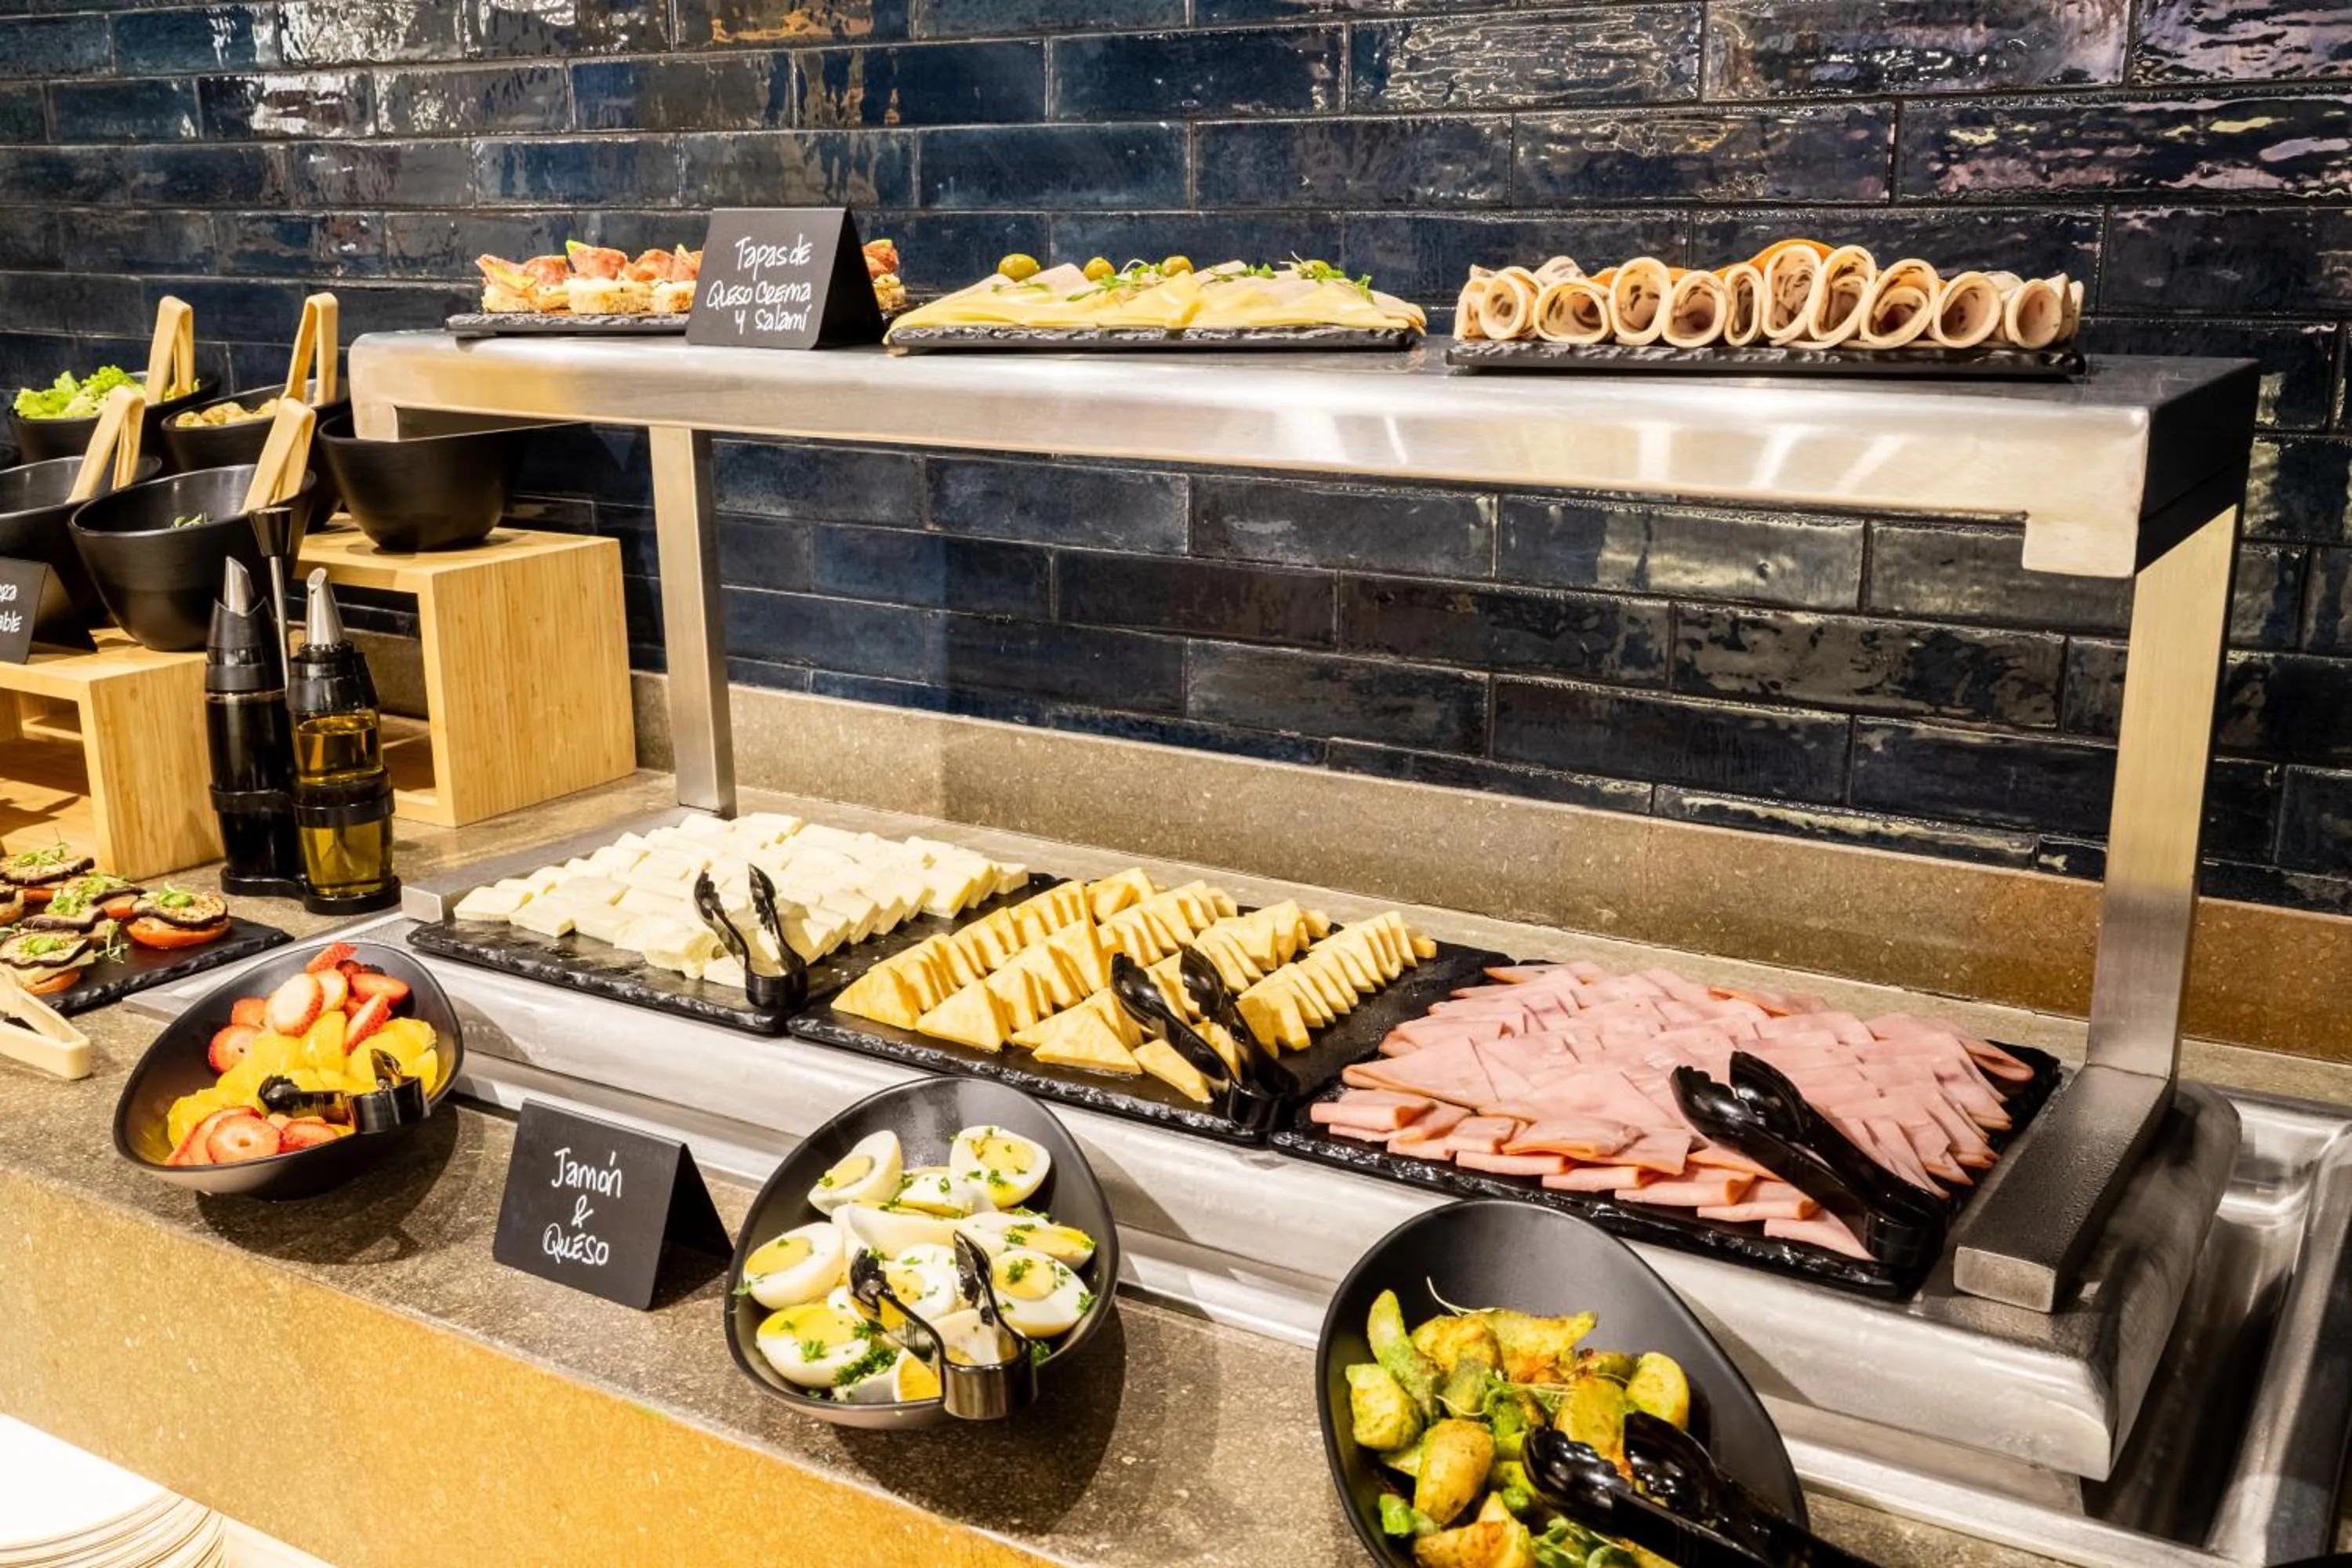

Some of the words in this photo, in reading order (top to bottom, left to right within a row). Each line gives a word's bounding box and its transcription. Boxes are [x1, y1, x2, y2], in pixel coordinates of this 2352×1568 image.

[734, 235, 788, 282] Tapas
[550, 1146, 622, 1199] Jamón
[571, 1193, 594, 1229] &
